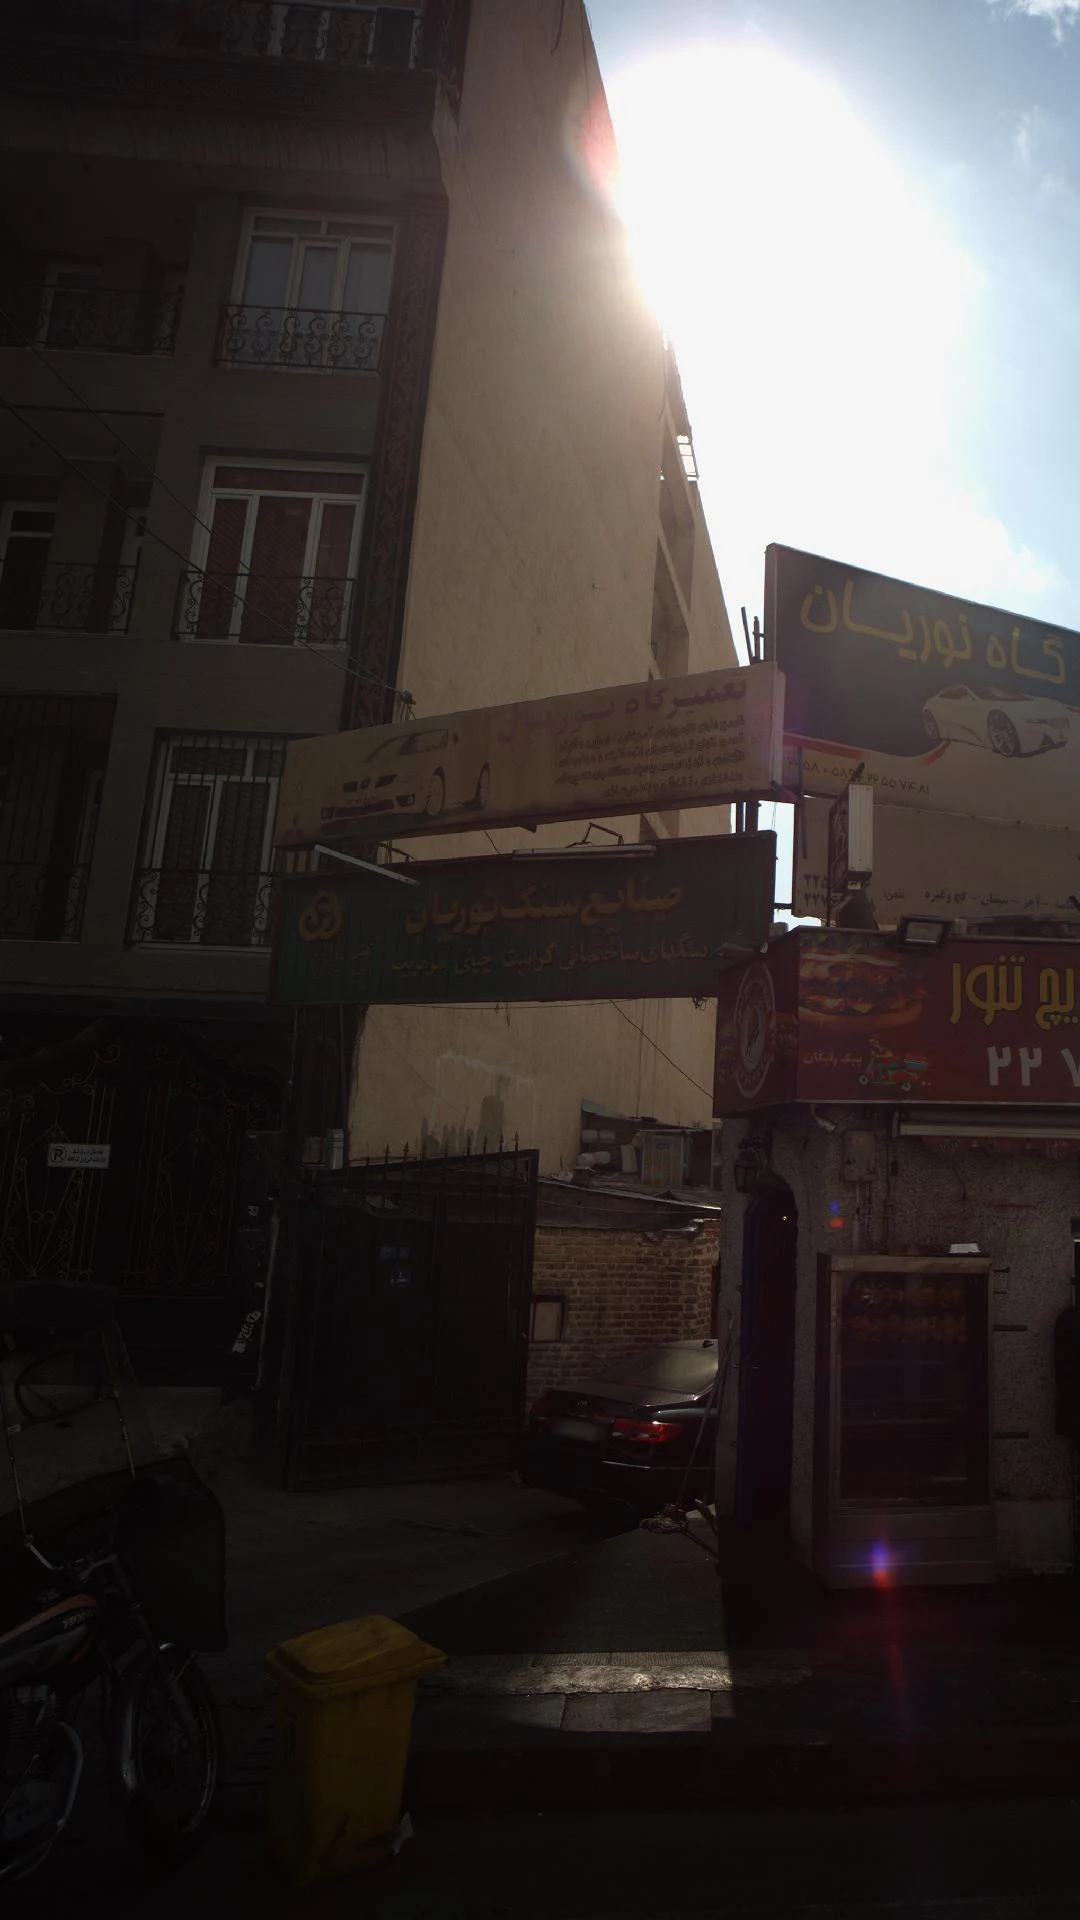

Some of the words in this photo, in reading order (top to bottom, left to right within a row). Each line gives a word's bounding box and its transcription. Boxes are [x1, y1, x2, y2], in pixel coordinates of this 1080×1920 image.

[799, 576, 973, 669] نوریان
[500, 878, 583, 919] سنگ
[580, 874, 684, 934] صنایع
[949, 952, 1026, 1026] تنور
